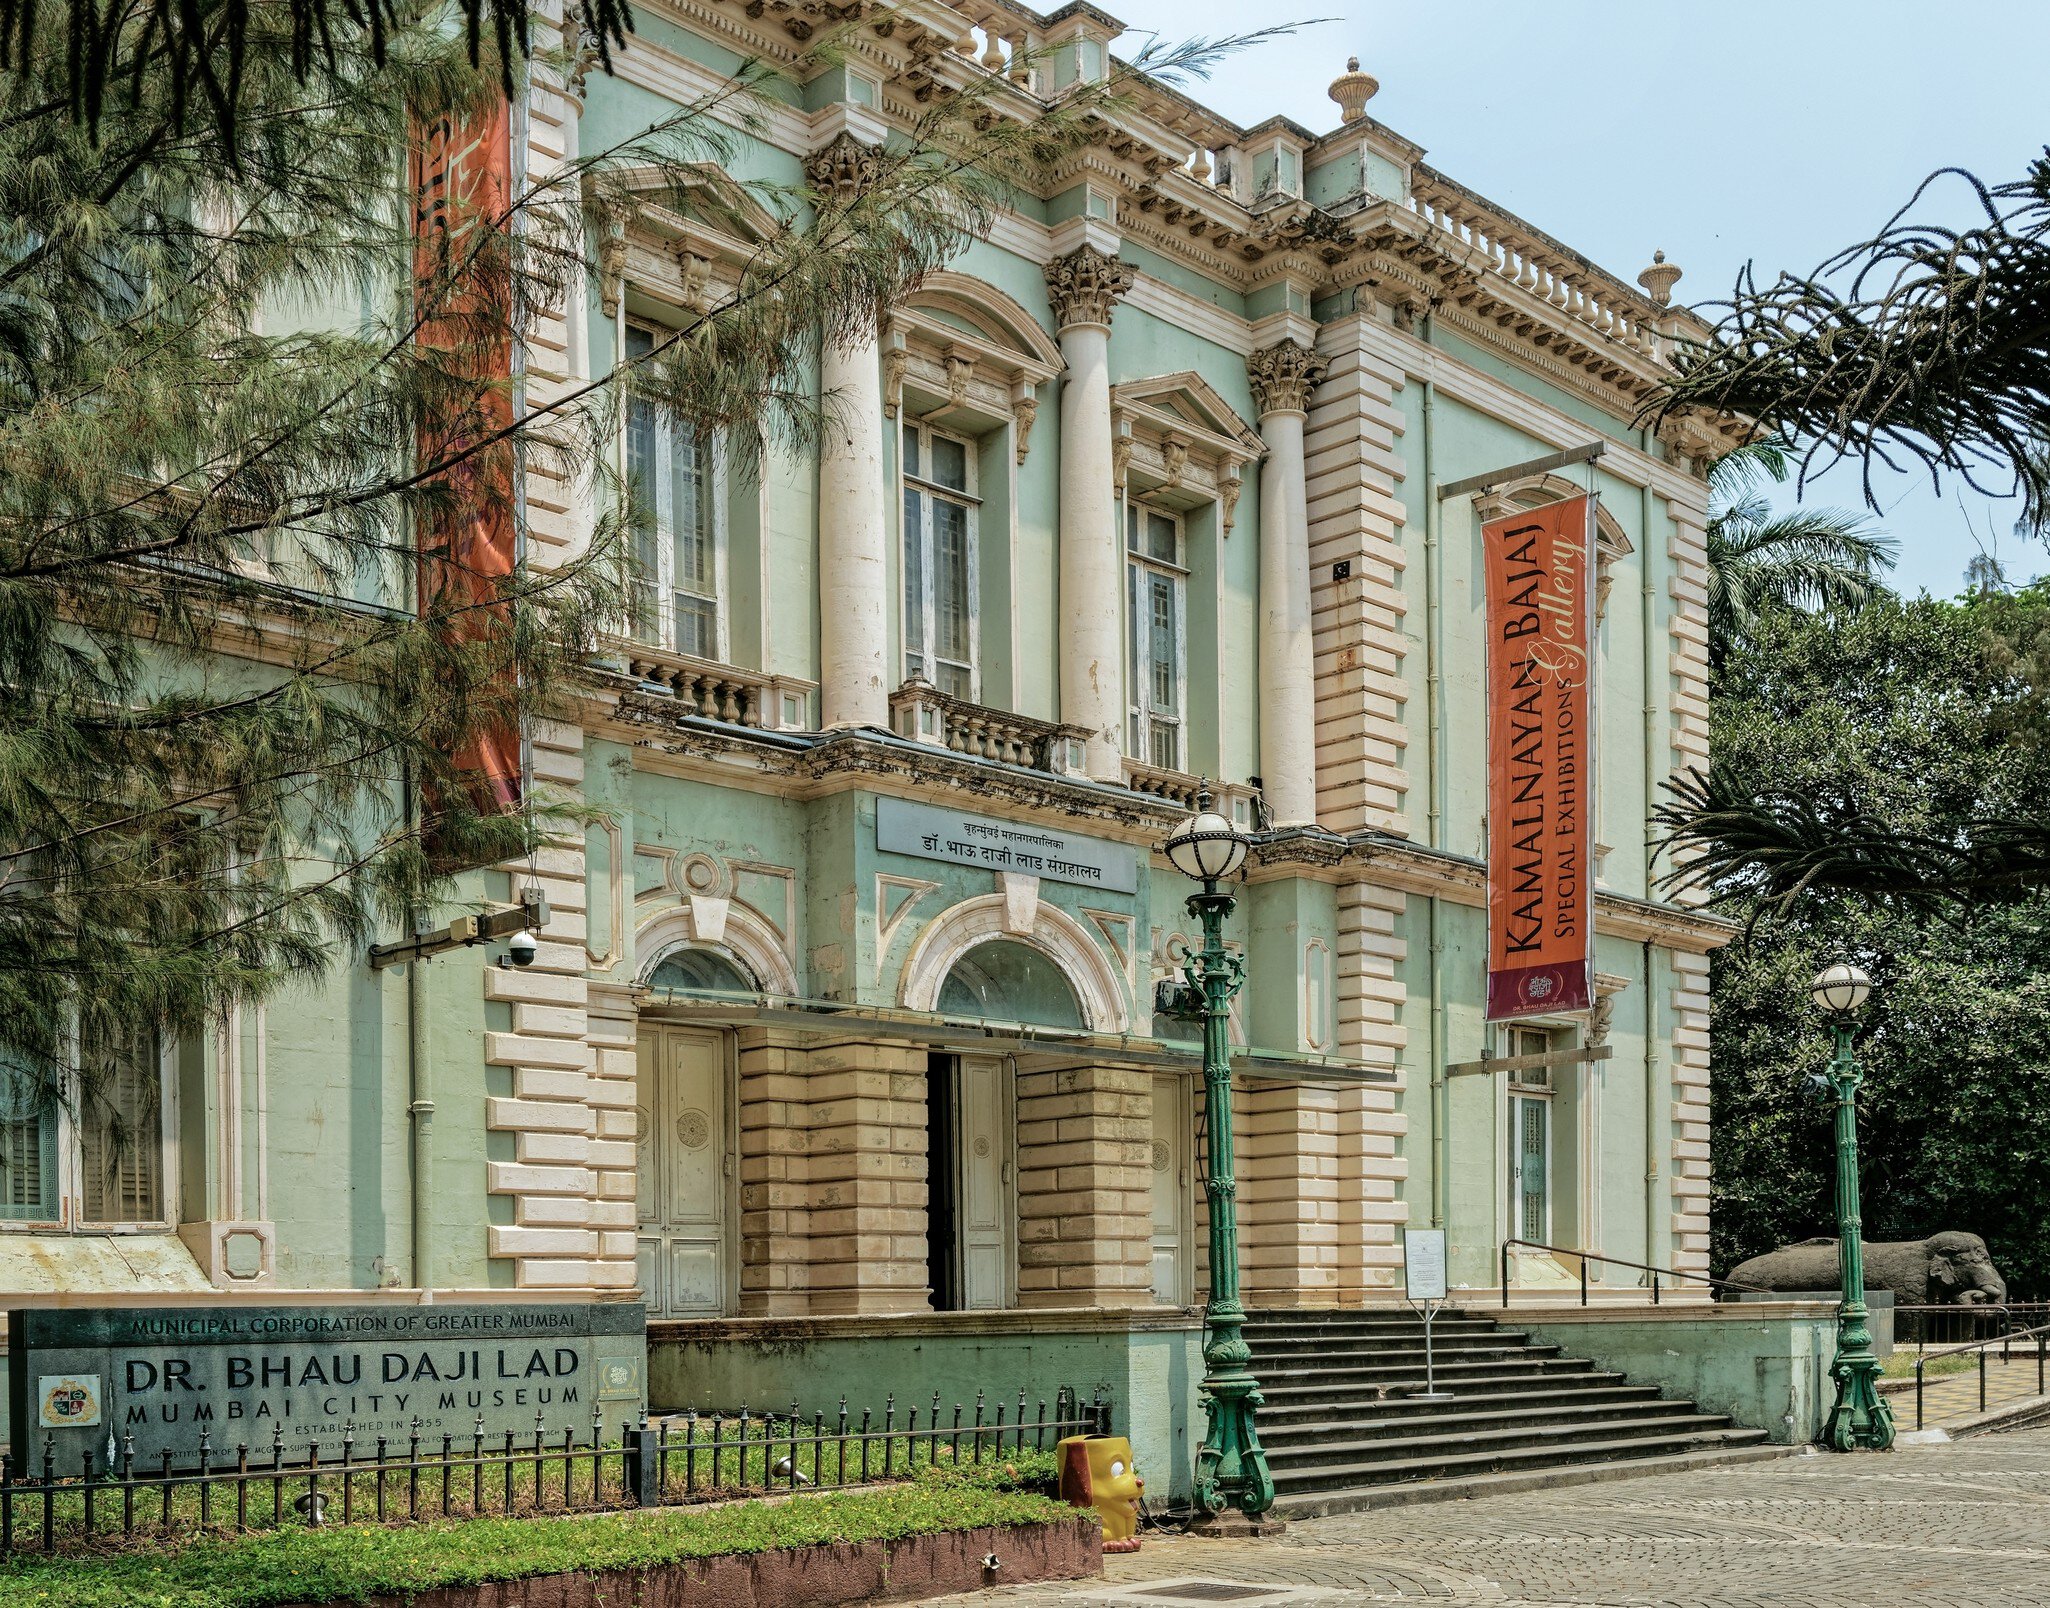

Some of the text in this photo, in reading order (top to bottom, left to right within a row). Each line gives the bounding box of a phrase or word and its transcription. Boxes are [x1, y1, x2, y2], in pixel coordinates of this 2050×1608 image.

[1502, 523, 1548, 645] BAJAJ
[1525, 533, 1587, 688] Gallery
[1505, 657, 1544, 958] KAMALNAYAN
[1554, 676, 1576, 938] SPECIAL EXHIBITIONS
[921, 832, 1102, 881] डॉ. भाऊ दाजी लाड संग्रहालय
[963, 822, 1064, 850] बृहन्मुंबई महानगरपालिका
[131, 1313, 574, 1335] MUNICIPAL CORPORATION OF GREATER MUMBAI
[126, 1359, 206, 1394] DR.
[227, 1353, 361, 1390] BHAU
[382, 1350, 480, 1384] DAJI
[497, 1348, 579, 1379] LAD
[125, 1386, 579, 1425] MUMBAI CITY MUSEUM
[295, 1418, 442, 1435] ESTABLSHED IN 855
[221, 1448, 231, 1456] OF
[290, 1442, 335, 1452] SUPPTED
